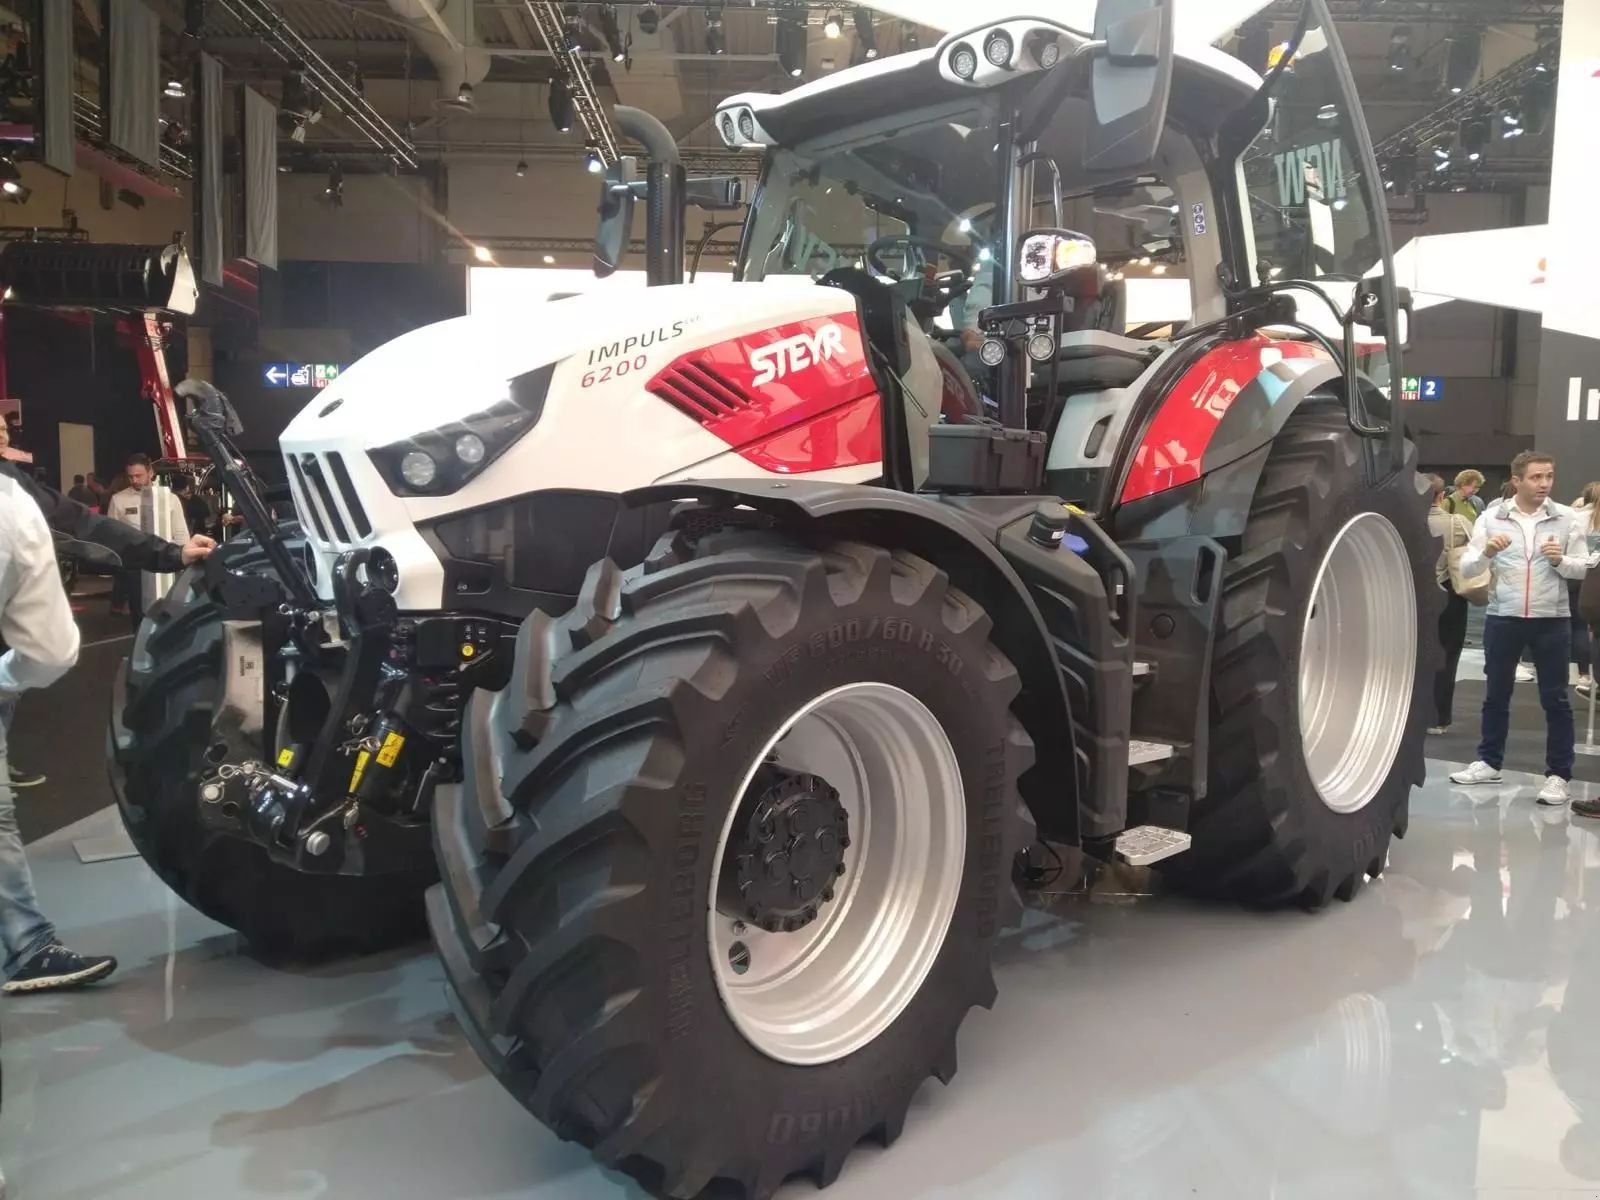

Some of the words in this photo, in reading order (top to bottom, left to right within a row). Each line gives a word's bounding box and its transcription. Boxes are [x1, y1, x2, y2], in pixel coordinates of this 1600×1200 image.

[587, 321, 684, 365] IMPULS
[750, 323, 848, 388] STEYR
[581, 354, 648, 388] 6200
[1424, 380, 1436, 396] 2
[935, 639, 965, 677] 30
